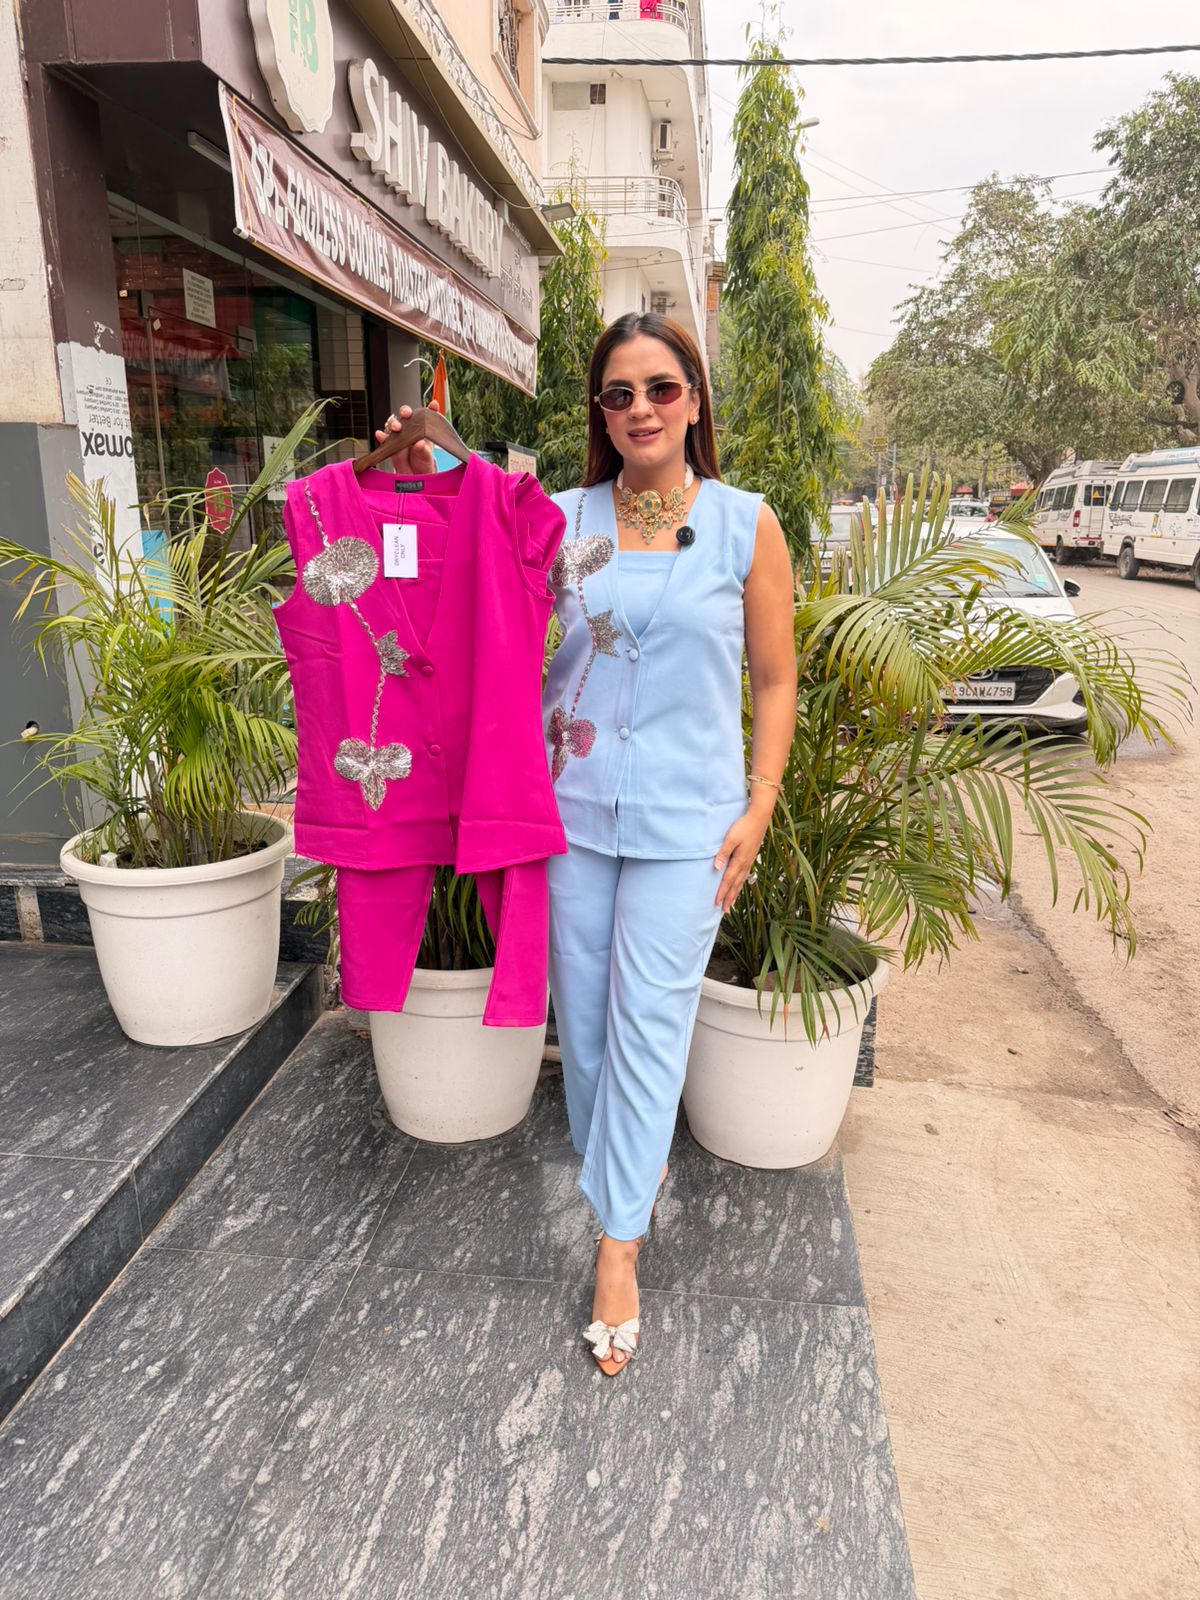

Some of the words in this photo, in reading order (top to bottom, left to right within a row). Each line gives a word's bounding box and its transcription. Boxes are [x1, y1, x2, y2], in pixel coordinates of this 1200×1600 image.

[351, 58, 429, 208] SHIV
[430, 142, 503, 278] BAKERY
[287, 164, 345, 266] EGGLESS
[345, 208, 393, 307] COOKIES,
[89, 413, 112, 428] Better
[113, 417, 123, 429] for
[945, 686, 1013, 697] 9CAW4758
